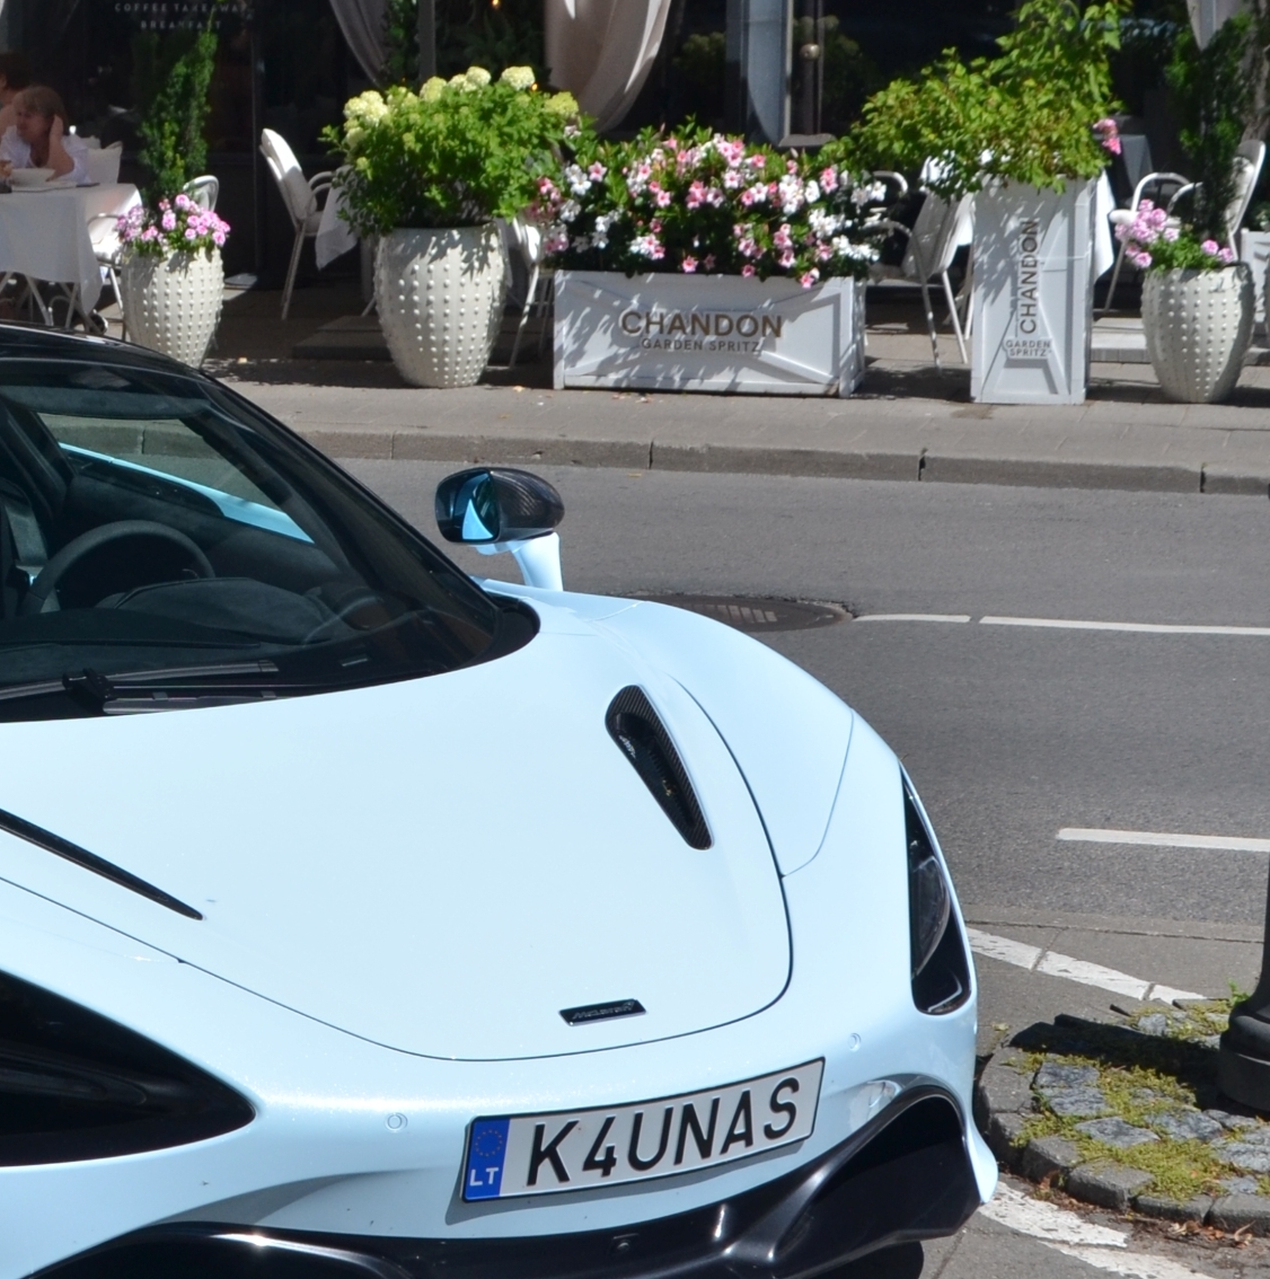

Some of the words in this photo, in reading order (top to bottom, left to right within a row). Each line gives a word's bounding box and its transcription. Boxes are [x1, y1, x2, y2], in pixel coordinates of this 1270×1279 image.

[115, 3, 168, 13] COFFEE
[141, 20, 221, 30] BREAKFAT
[1019, 220, 1038, 334] CHANDON
[621, 311, 783, 338] CHANDON
[641, 338, 703, 351] GARDEN
[708, 341, 761, 353] SPRITZ
[1005, 339, 1052, 349] GARDEN
[1009, 348, 1047, 357] SPRITZ
[469, 1166, 499, 1187] LT
[526, 1076, 801, 1187] K4UNAS
